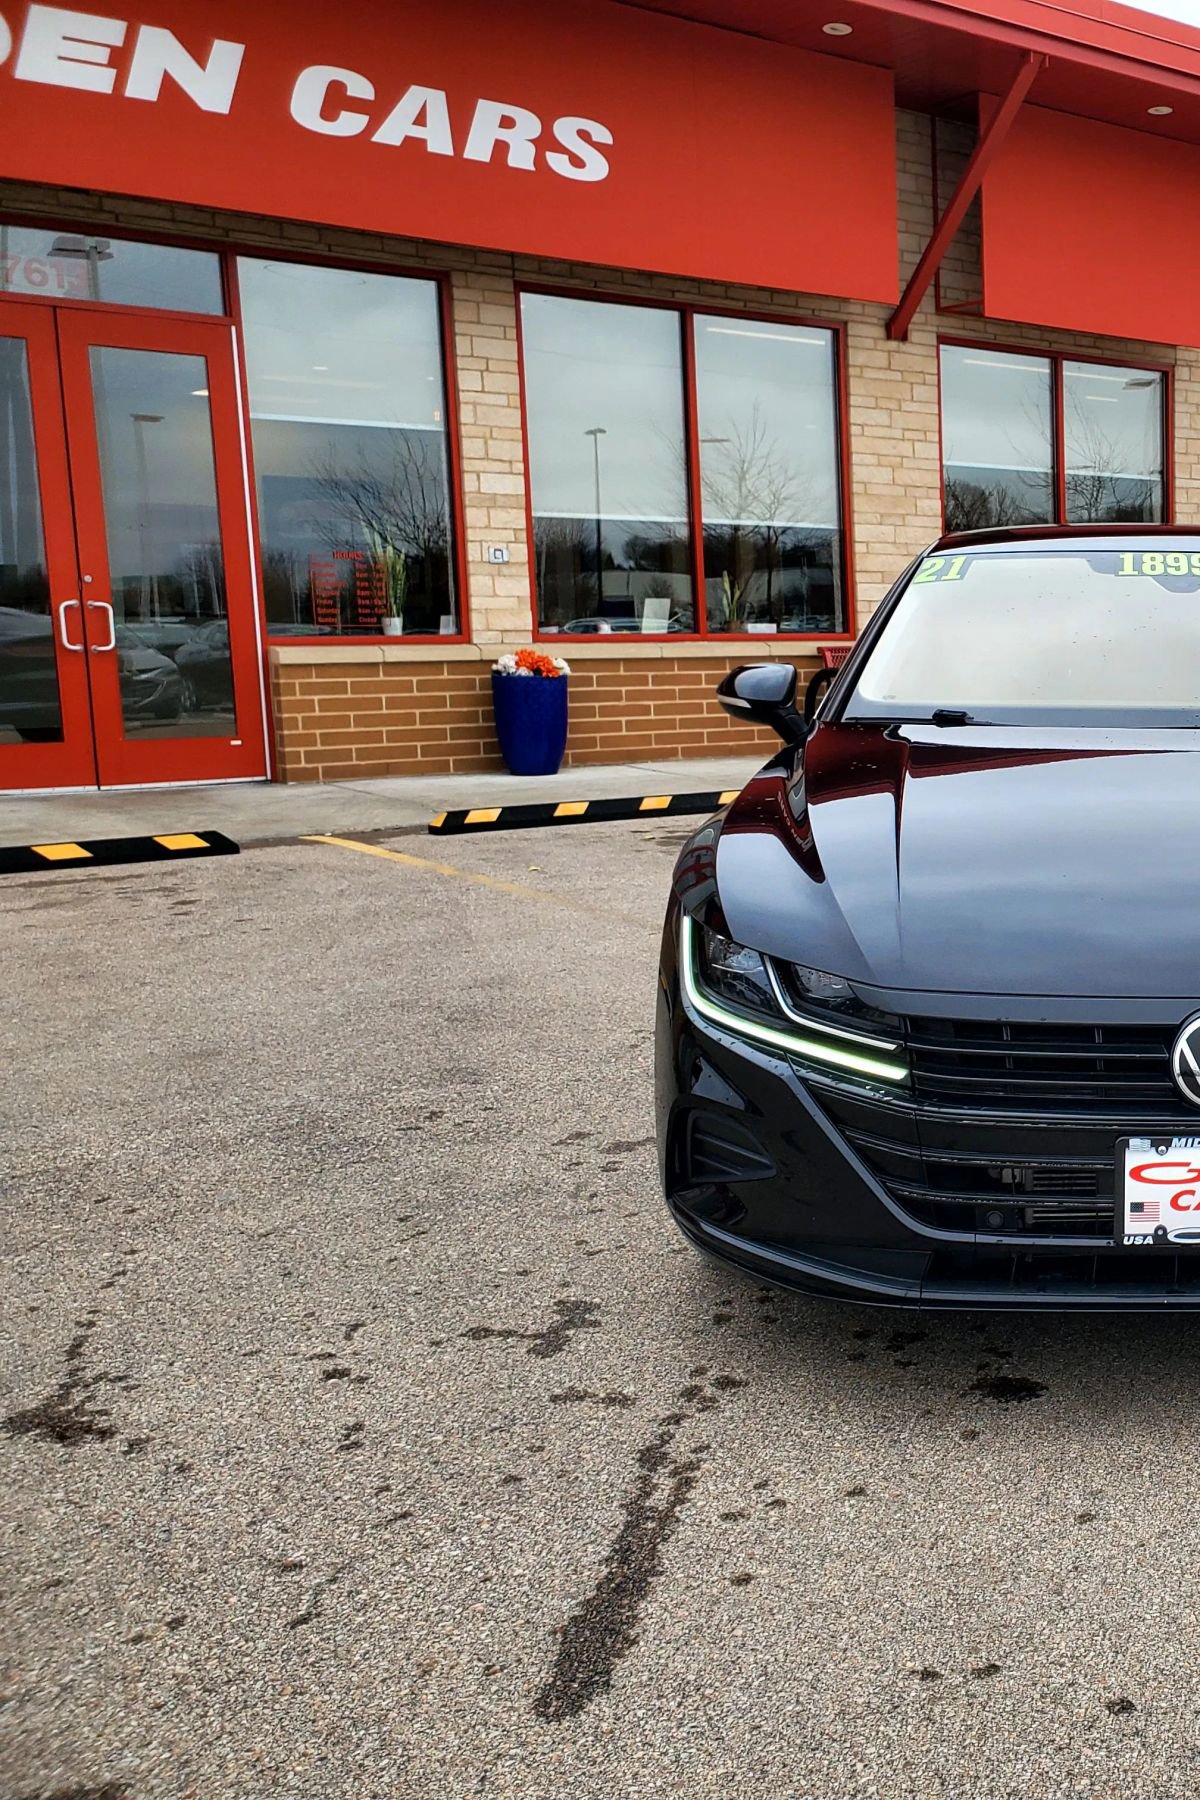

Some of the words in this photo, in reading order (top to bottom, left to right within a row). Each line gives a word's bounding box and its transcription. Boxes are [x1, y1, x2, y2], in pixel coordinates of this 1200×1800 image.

[290, 65, 614, 182] CARS
[913, 556, 967, 584] 21
[1123, 1235, 1154, 1245] USA
